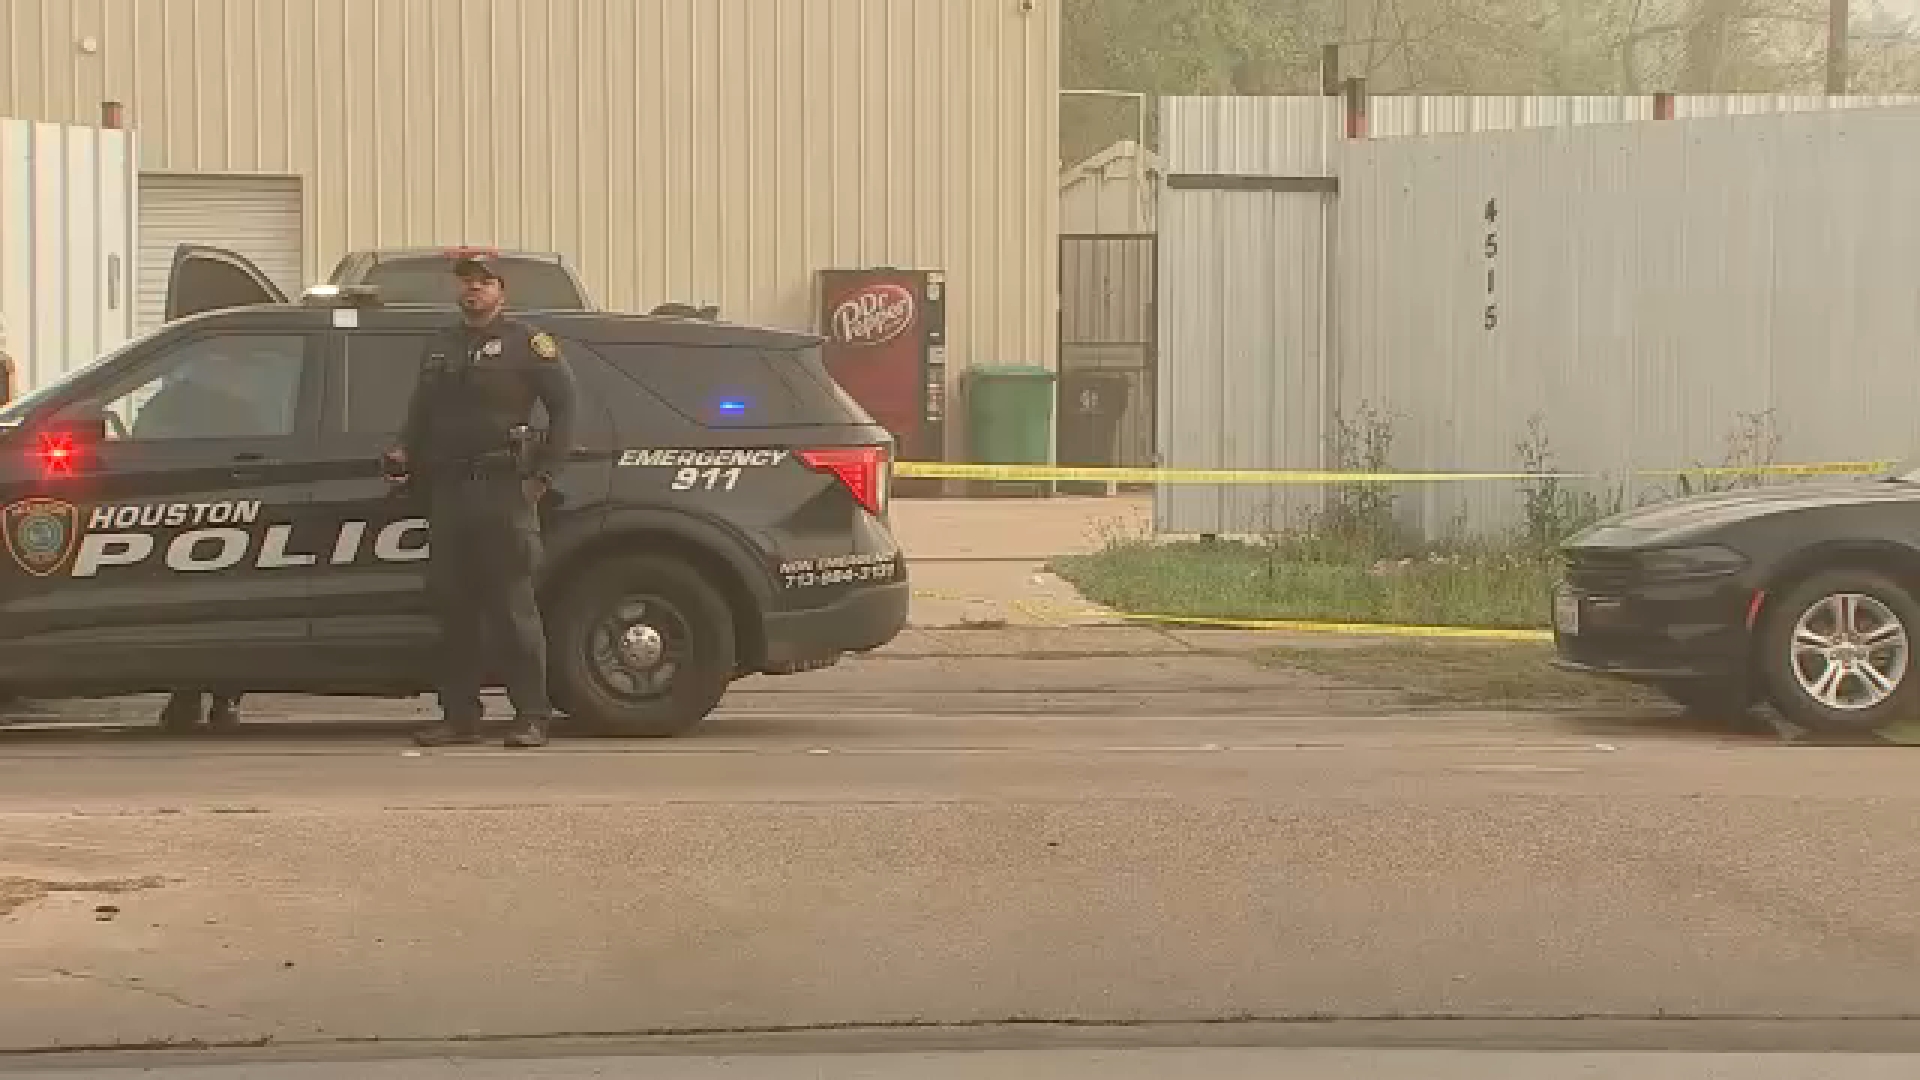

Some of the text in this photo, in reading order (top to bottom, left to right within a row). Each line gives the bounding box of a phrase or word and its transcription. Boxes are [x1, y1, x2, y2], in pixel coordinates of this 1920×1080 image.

[1484, 197, 1498, 331] 4515
[860, 293, 889, 316] Dr
[835, 299, 908, 342] Pepper
[617, 449, 790, 467] EMERGENCY
[671, 467, 742, 490] 911
[87, 500, 262, 529] HOUSTON
[71, 517, 431, 577] POLIC
